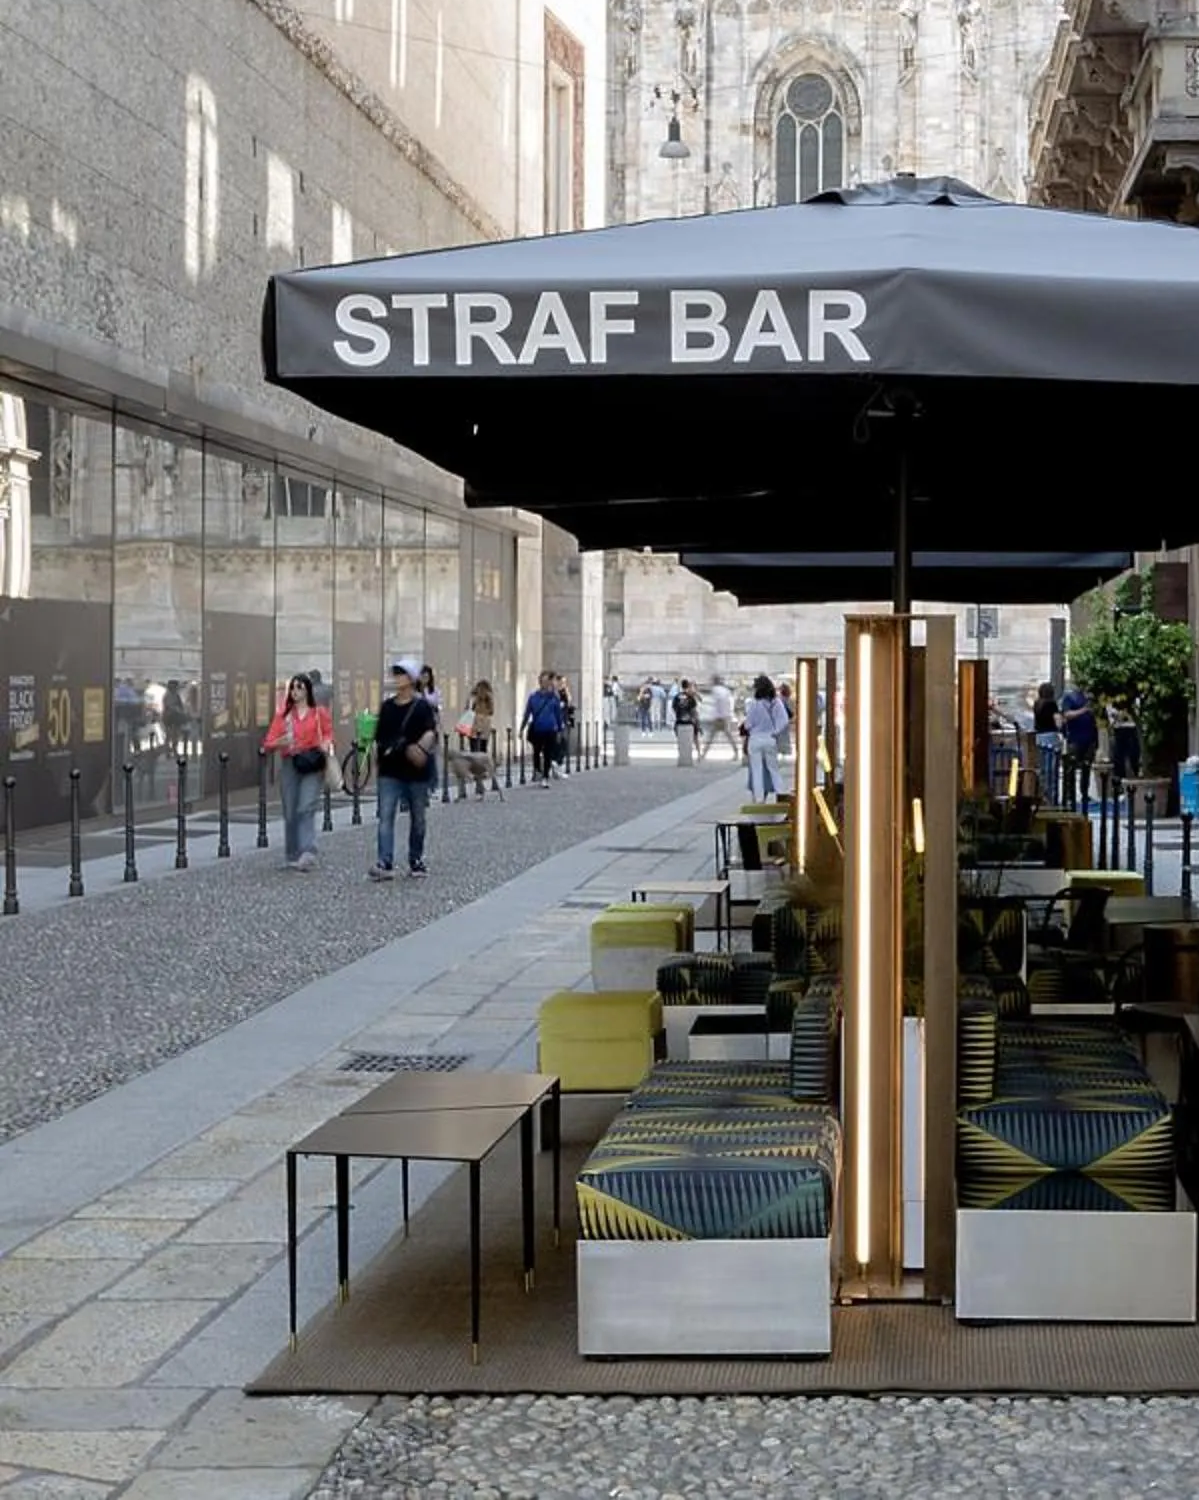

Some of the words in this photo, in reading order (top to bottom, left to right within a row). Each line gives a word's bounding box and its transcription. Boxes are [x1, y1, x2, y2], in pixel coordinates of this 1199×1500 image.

[333, 291, 640, 367] STRAF
[670, 288, 872, 364] BAR
[9, 690, 35, 708] BLACK
[48, 688, 71, 746] 50
